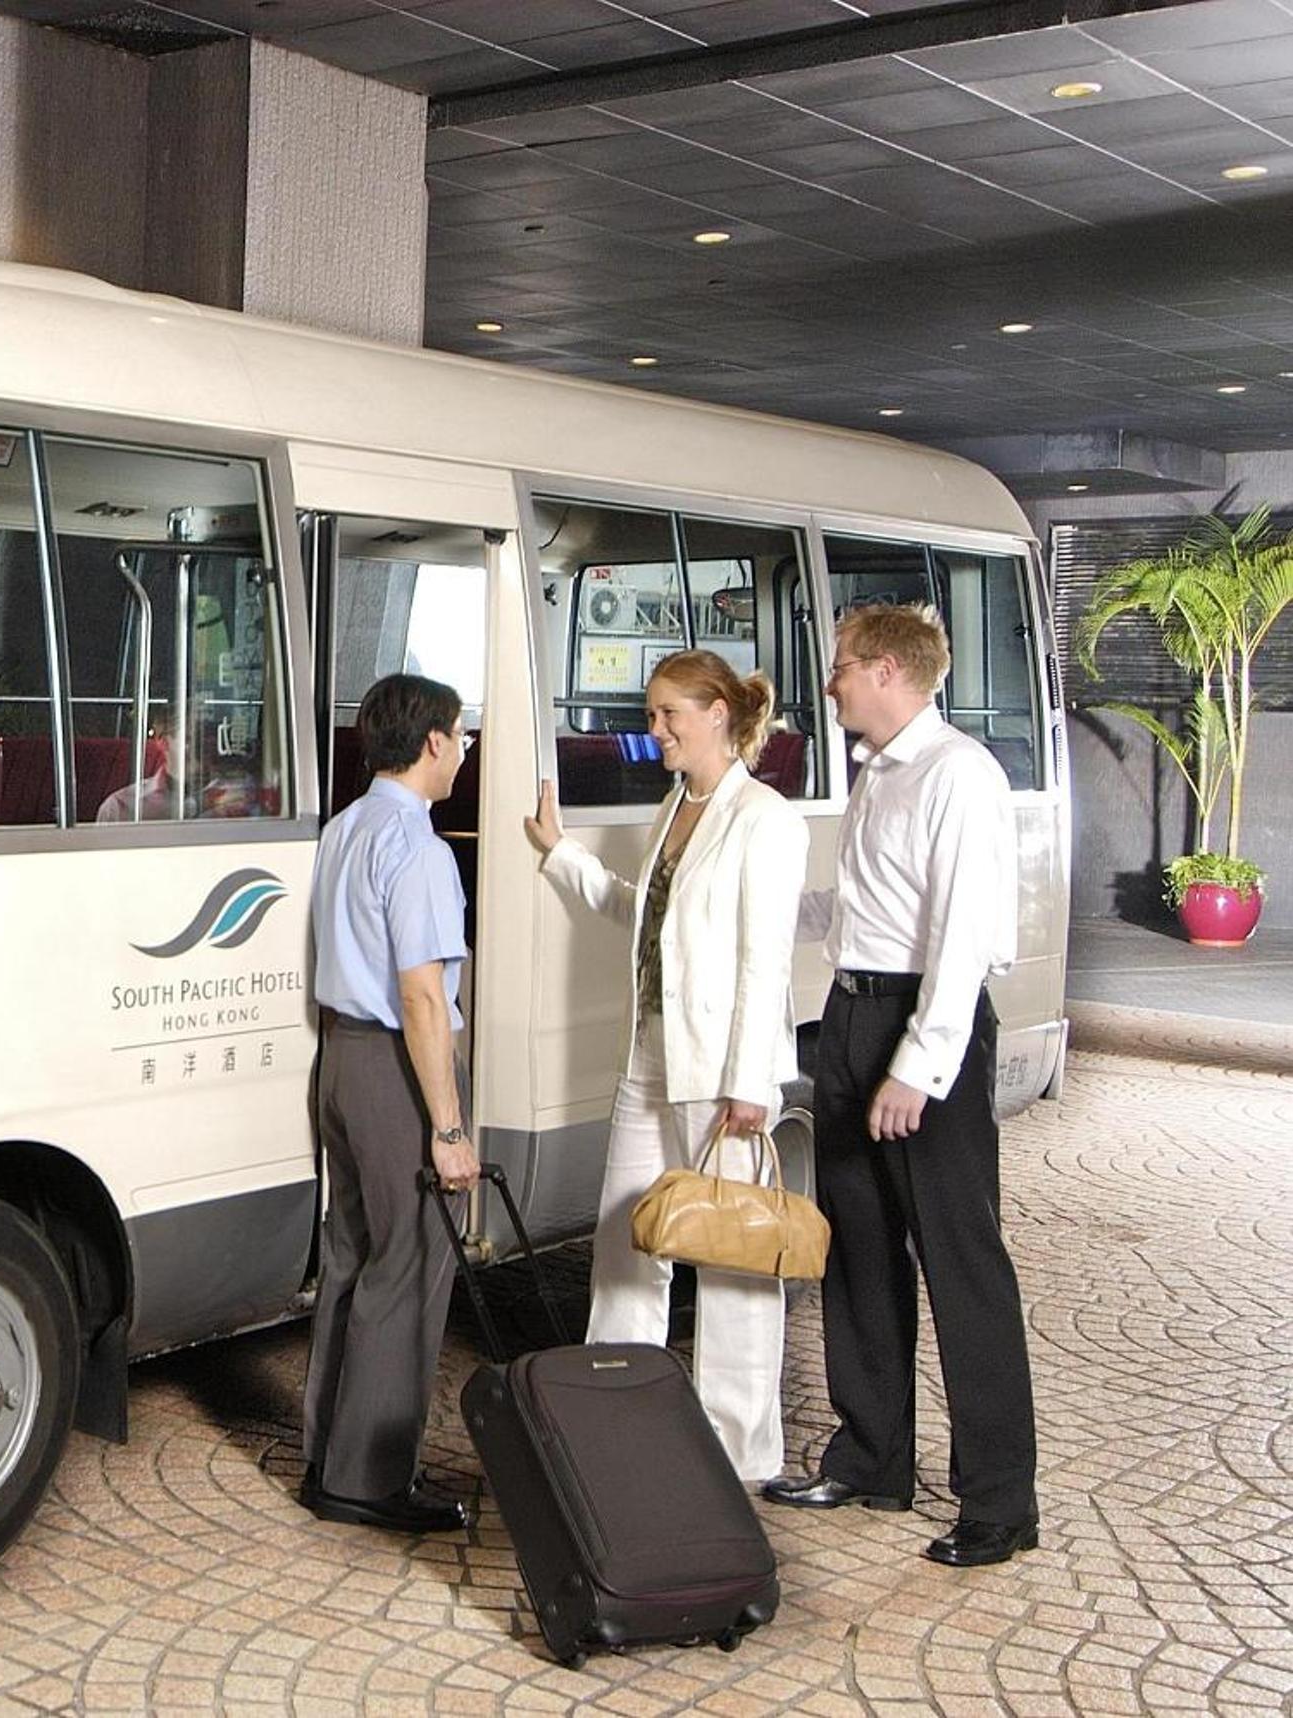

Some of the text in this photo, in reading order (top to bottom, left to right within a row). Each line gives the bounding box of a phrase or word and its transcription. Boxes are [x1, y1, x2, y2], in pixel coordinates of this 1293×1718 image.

[111, 971, 303, 1011] SOUTH PACIFIC HOTEL
[162, 1006, 260, 1032] HONG KONG
[140, 1041, 274, 1085] 南洋酒店
